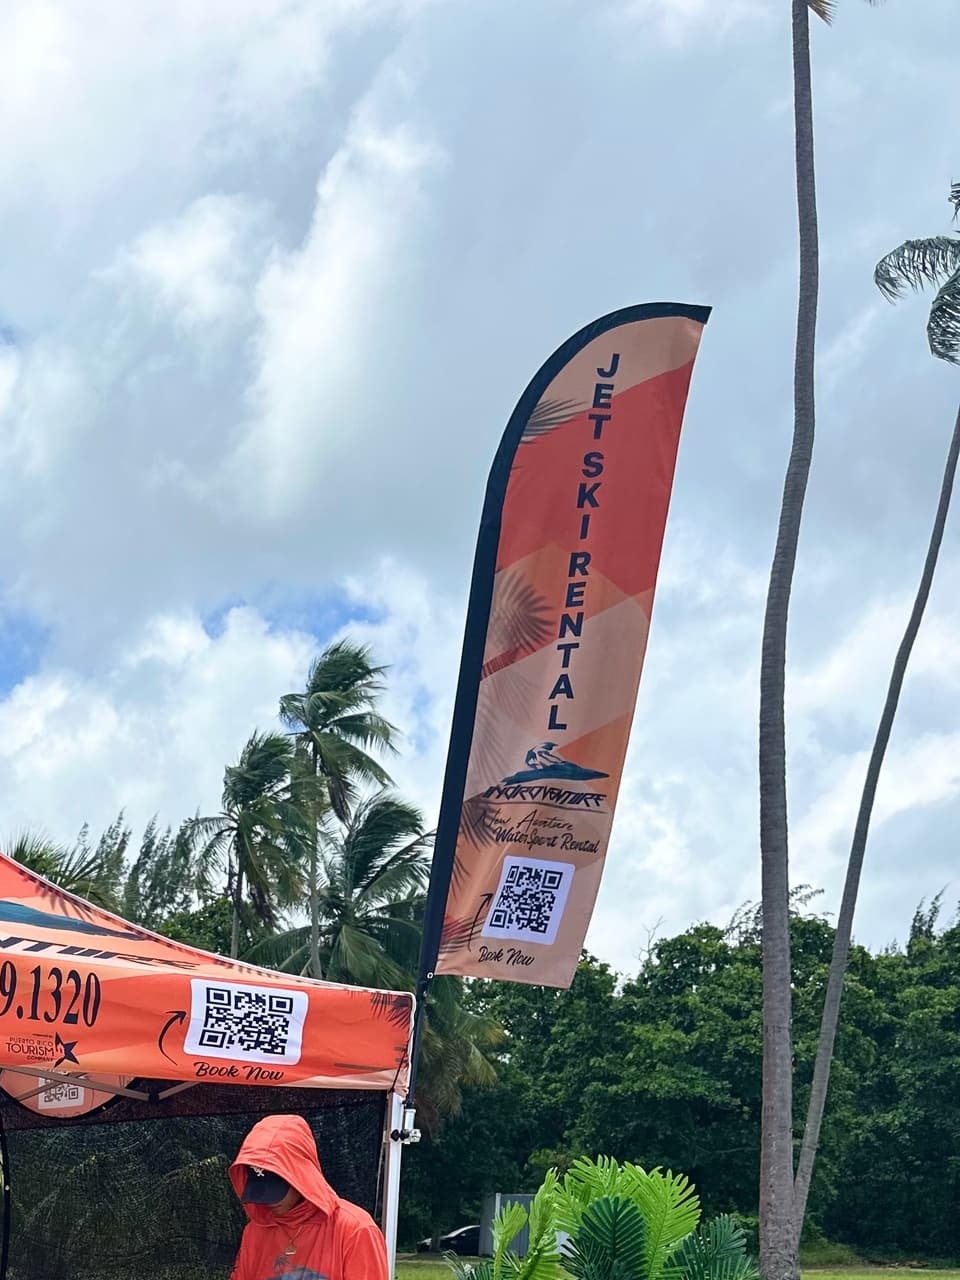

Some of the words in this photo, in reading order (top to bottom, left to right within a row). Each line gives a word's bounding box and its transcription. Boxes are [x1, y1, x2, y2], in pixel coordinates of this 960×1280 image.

[587, 353, 620, 440] JET
[576, 451, 605, 540] SKI
[548, 551, 592, 730] RENTAL
[482, 784, 608, 808] HYDROVENTURE
[559, 832, 600, 854] Rental
[478, 946, 504, 964] Book
[506, 948, 536, 967] Now
[5, 1042, 55, 1057] TOURISM
[193, 1061, 239, 1078] Book
[242, 1065, 285, 1081] Now
